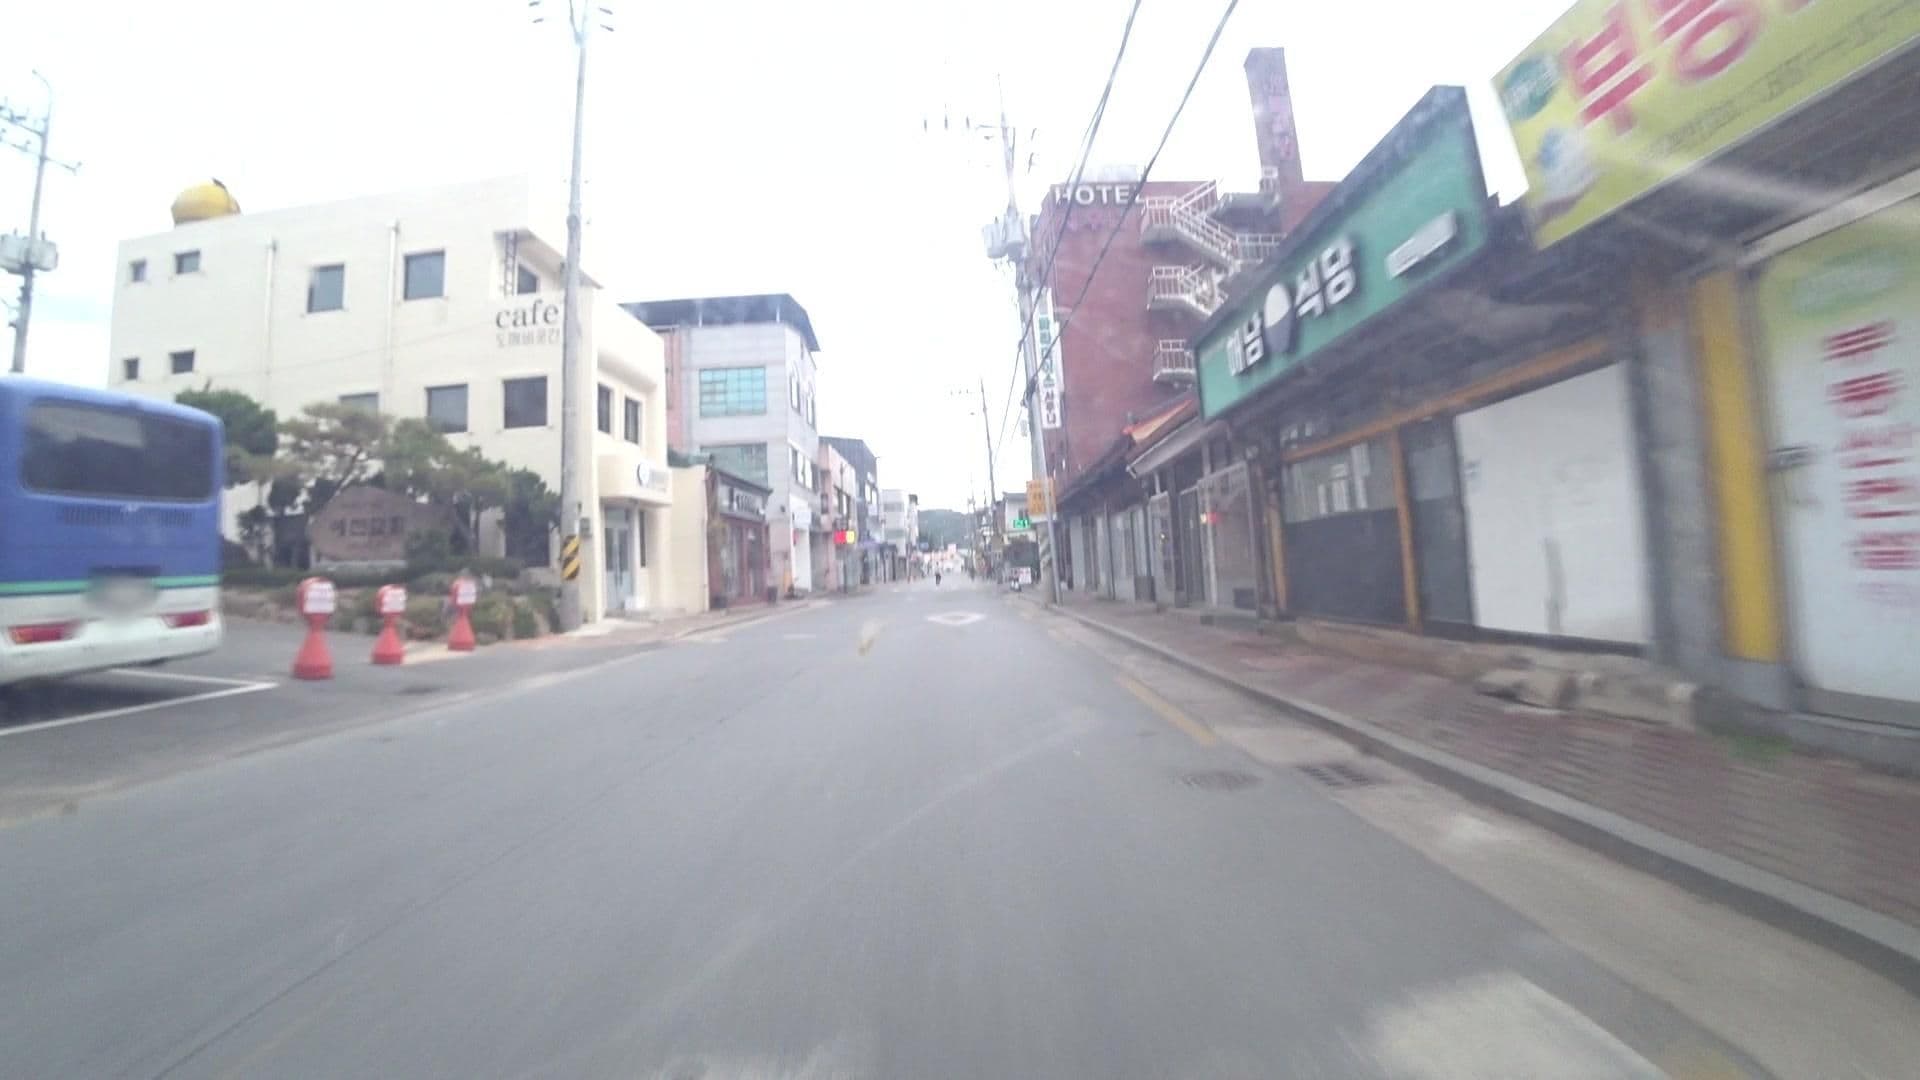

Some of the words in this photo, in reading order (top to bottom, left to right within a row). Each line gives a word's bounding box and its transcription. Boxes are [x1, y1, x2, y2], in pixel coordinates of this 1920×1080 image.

[1562, 0, 1812, 137] 부동
[1054, 185, 1145, 205] HOTEL
[1296, 237, 1356, 320] 식당
[496, 299, 559, 329] cafe
